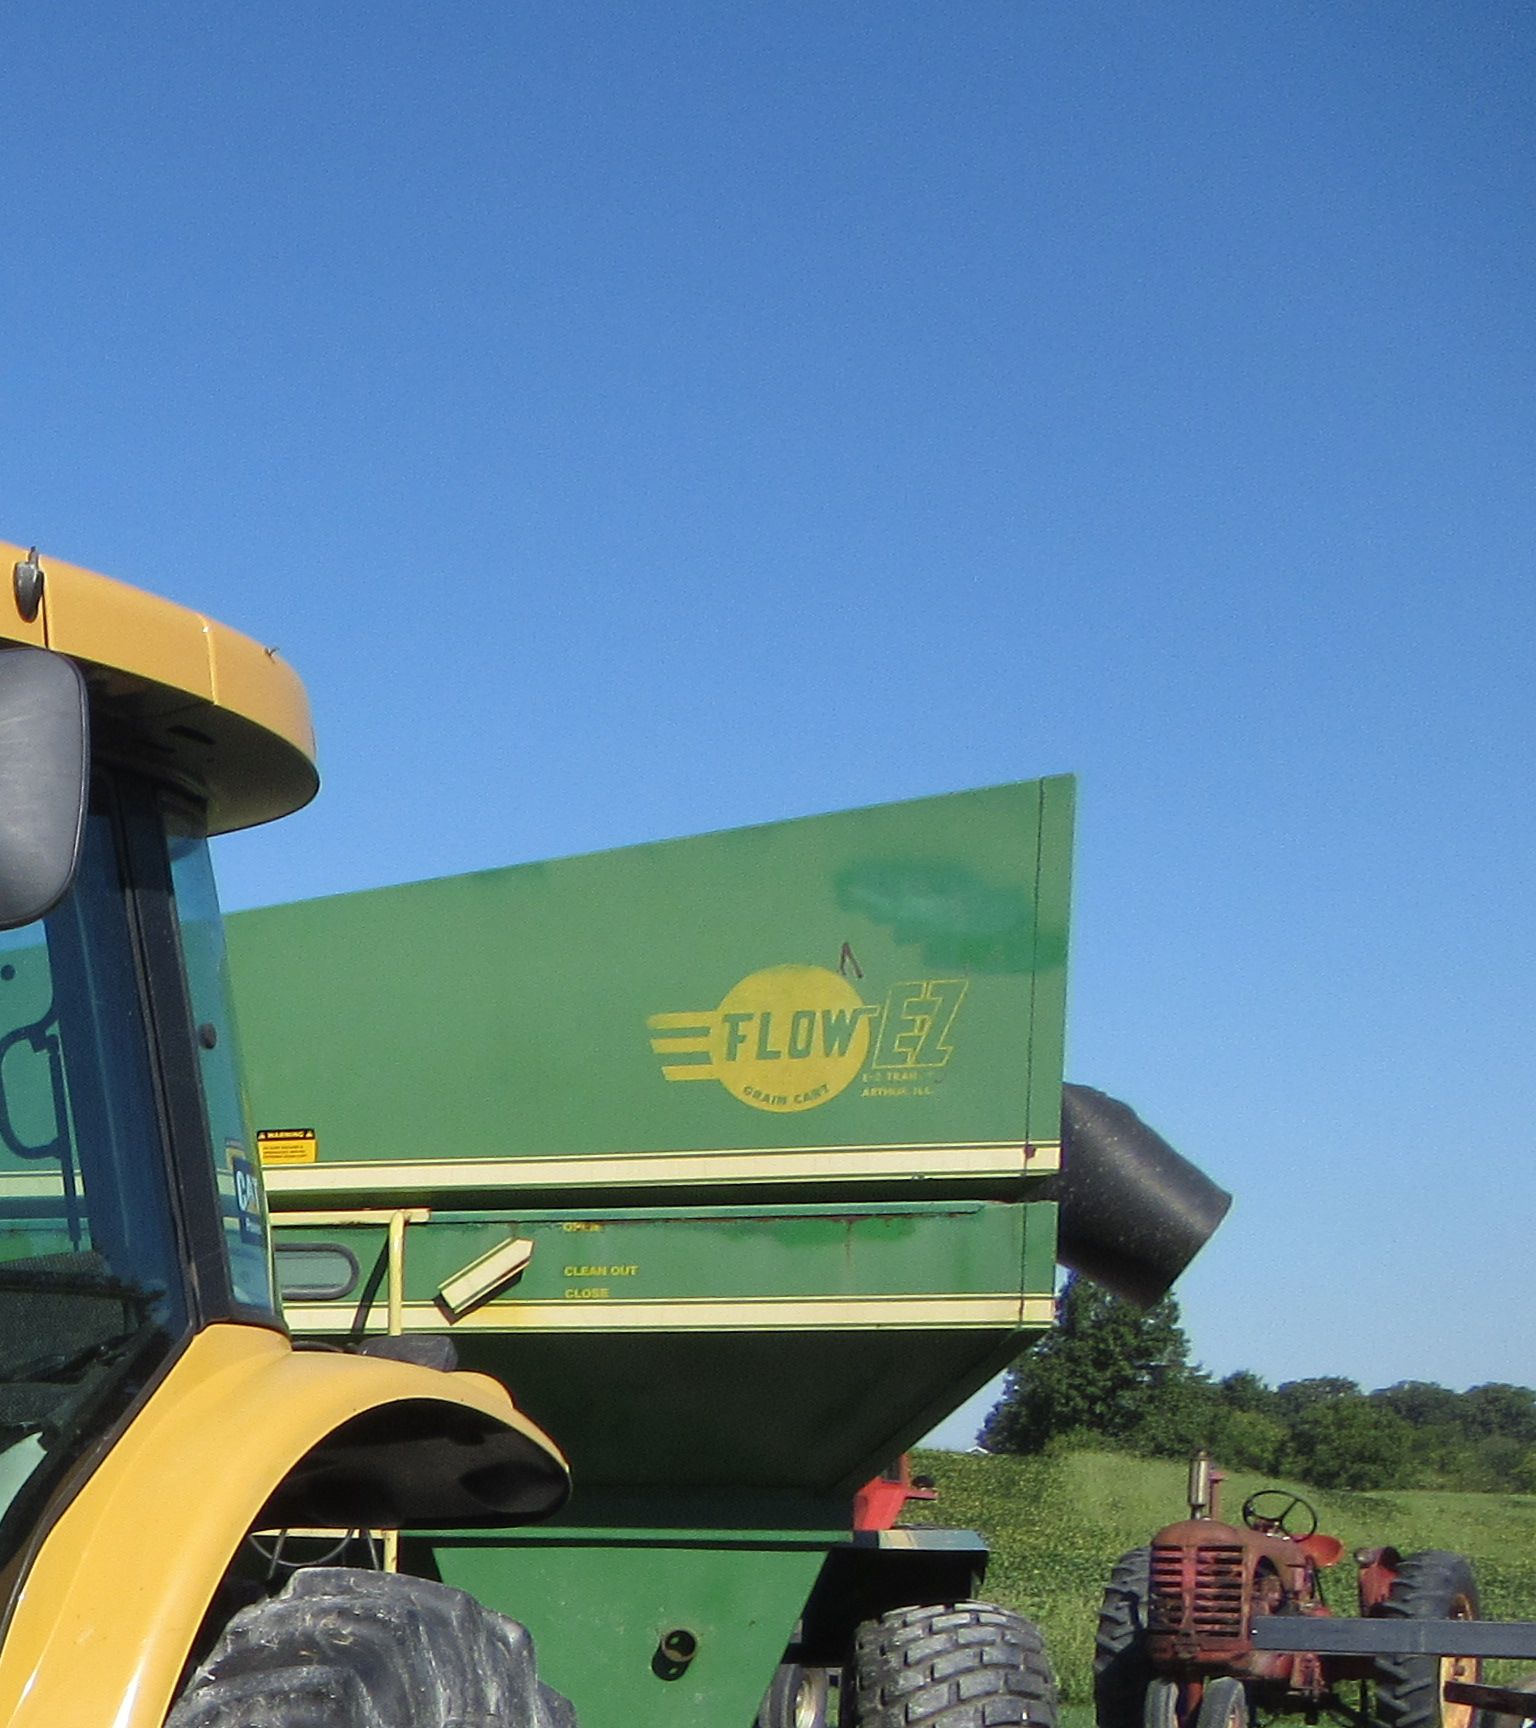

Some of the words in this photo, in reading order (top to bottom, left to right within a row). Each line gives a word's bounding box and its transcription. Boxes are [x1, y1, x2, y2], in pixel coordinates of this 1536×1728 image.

[721, 1005, 879, 1062] FLOW
[743, 1085, 788, 1105] GRAIN
[793, 1083, 828, 1104] CART
[564, 1266, 608, 1277] CLEAN
[610, 1265, 639, 1276] OUT
[565, 1288, 610, 1299] CLOSE
